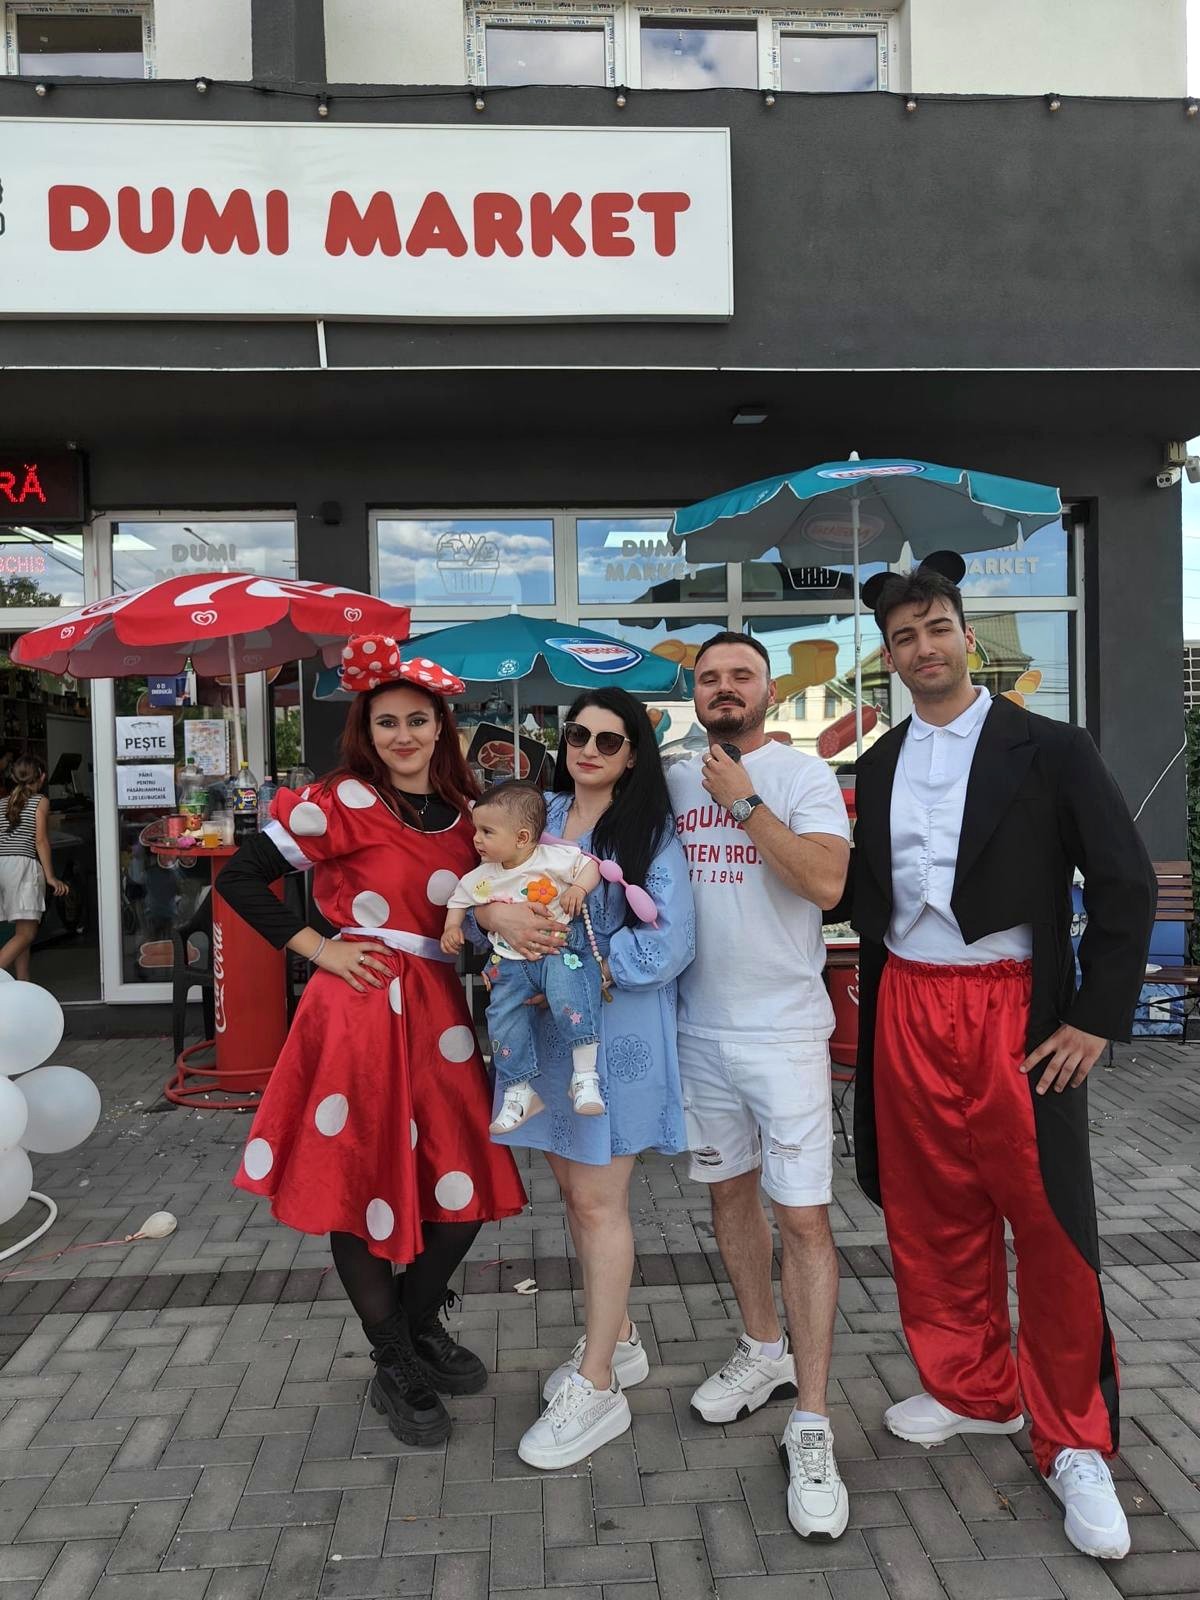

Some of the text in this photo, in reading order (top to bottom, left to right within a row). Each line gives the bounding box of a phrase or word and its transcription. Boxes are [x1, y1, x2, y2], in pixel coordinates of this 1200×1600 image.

[49, 186, 689, 256] DUMI MARKET
[171, 543, 237, 562] DUMI
[622, 539, 685, 557] DUM
[606, 563, 697, 581] MARKET
[966, 556, 1039, 576] ARKET
[125, 736, 167, 752] PEȘTE
[725, 845, 762, 864] BRO.
